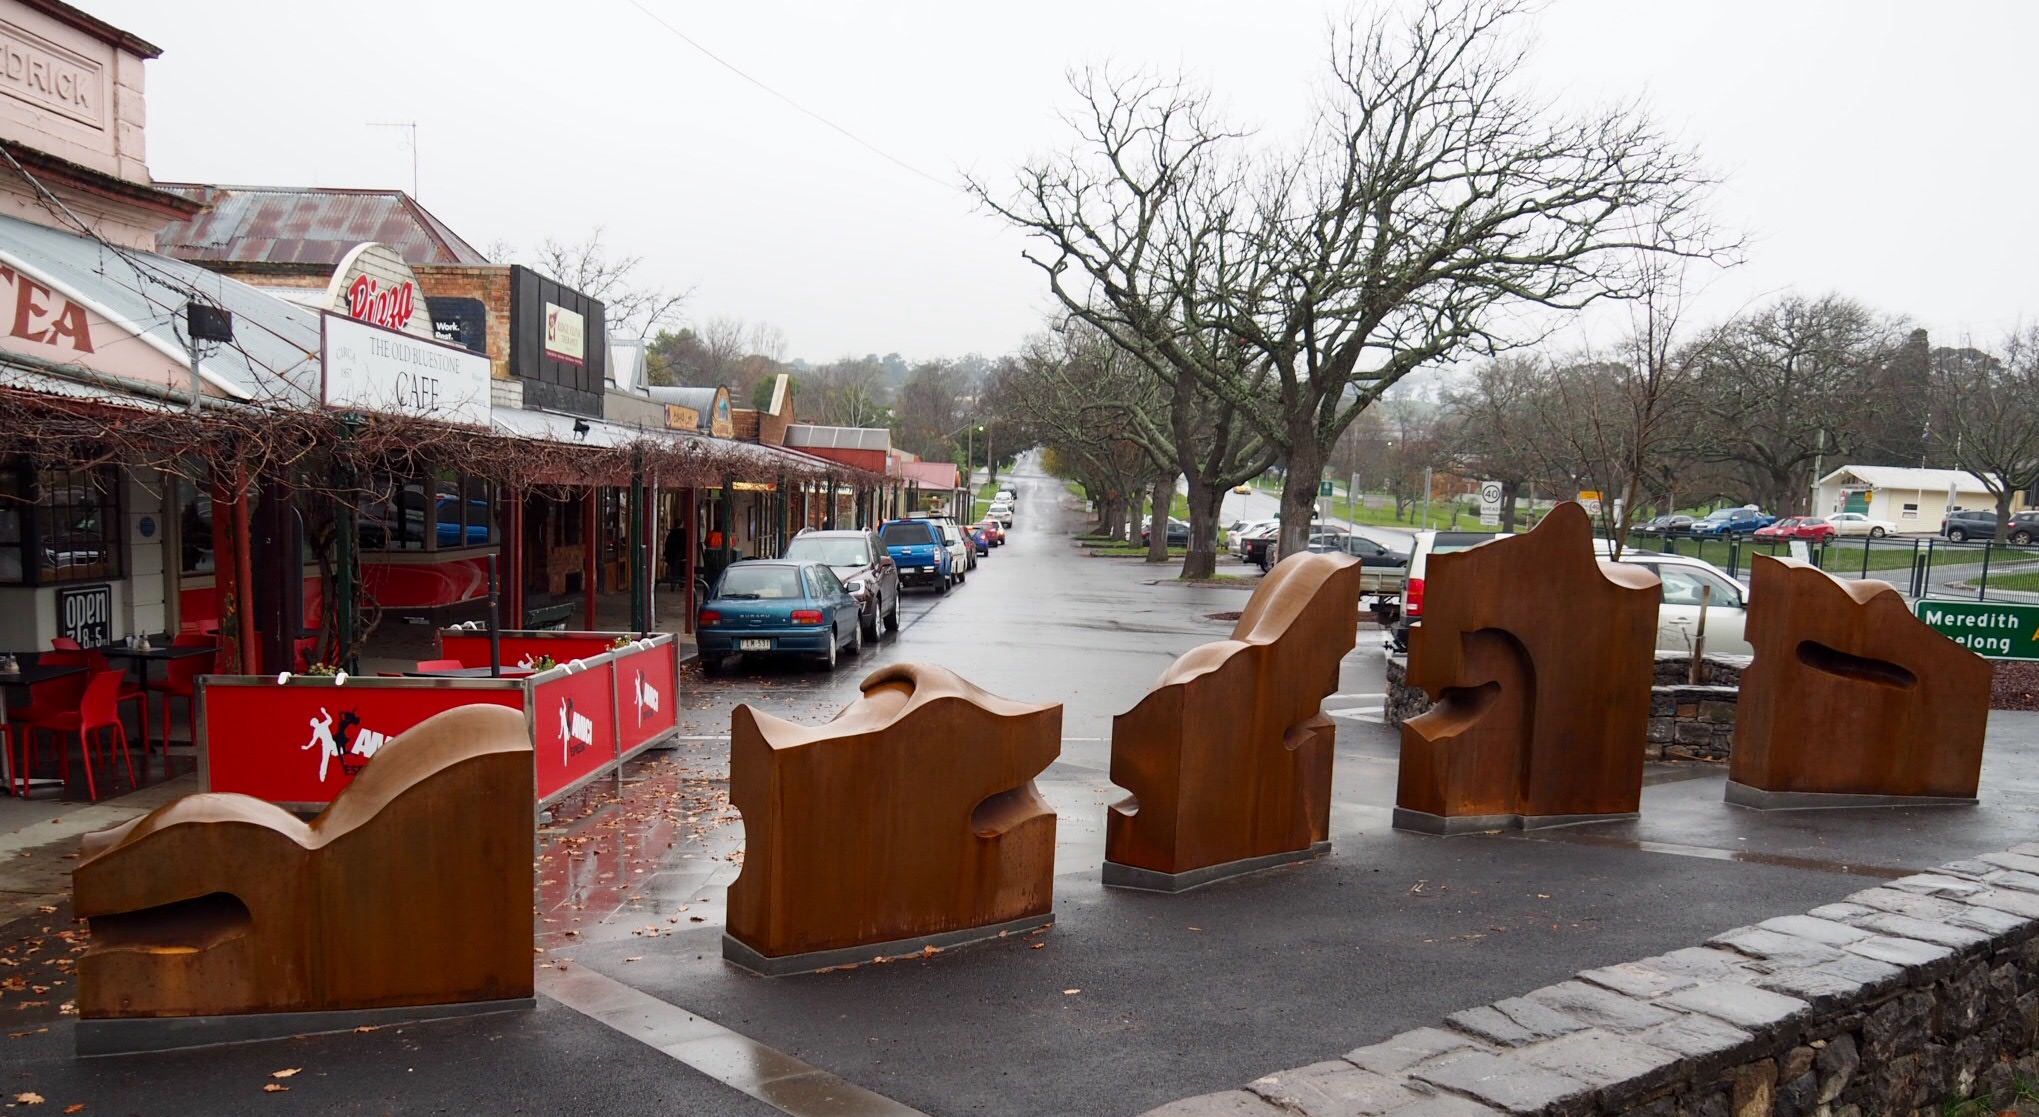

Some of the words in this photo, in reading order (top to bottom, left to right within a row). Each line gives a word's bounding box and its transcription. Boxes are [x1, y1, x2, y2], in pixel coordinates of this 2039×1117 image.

[0, 44, 89, 108] DRICK
[348, 273, 415, 329] Pizza
[436, 321, 460, 331] Work.
[369, 336, 389, 358] THE
[391, 342, 411, 362] OLD
[412, 347, 460, 374] BLUESTONE
[396, 371, 439, 411] CAFE
[1485, 490, 1498, 499] 40
[66, 592, 106, 643] open
[1925, 610, 2019, 629] Meredith
[1947, 634, 2011, 654] elong
